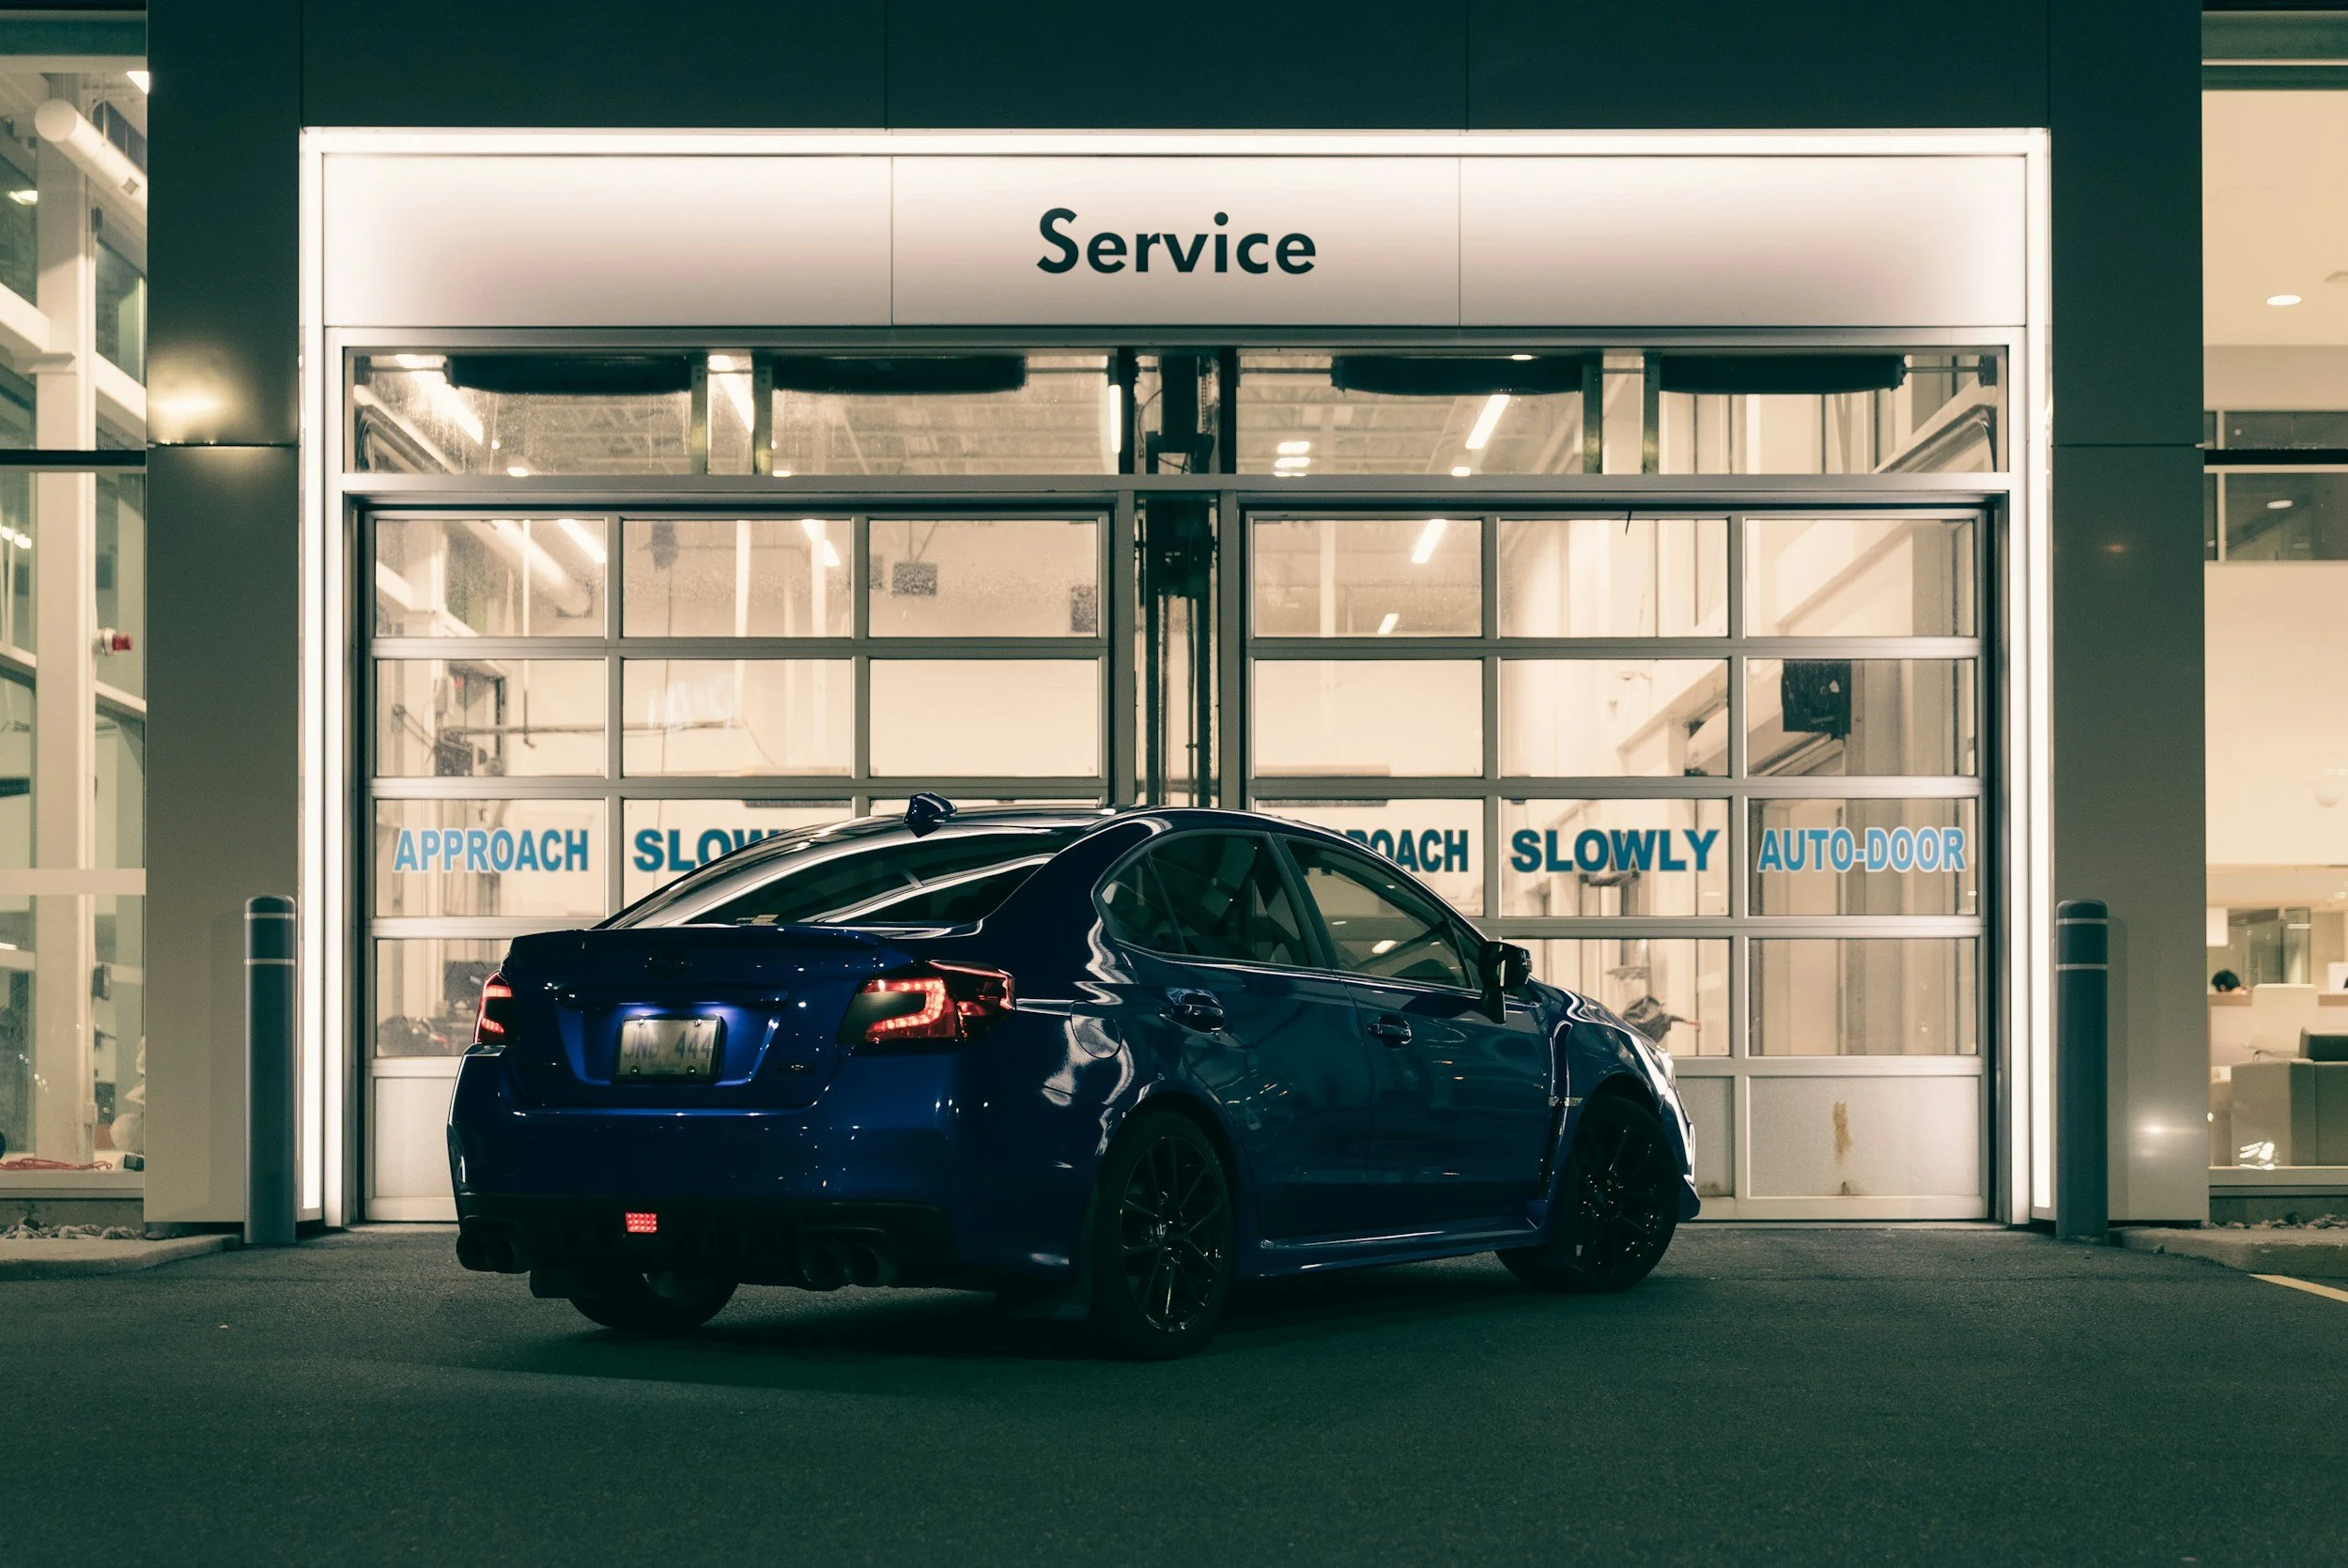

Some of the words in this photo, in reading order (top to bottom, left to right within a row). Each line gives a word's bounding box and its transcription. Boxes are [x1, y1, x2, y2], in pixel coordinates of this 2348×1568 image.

[1036, 207, 1316, 274] Service
[393, 828, 590, 872] APPROACH
[632, 828, 789, 872] SLO
[1334, 828, 1470, 872] OACH
[1510, 828, 1721, 873] SLOWLY
[1756, 826, 1967, 873] AUTO-DOOR
